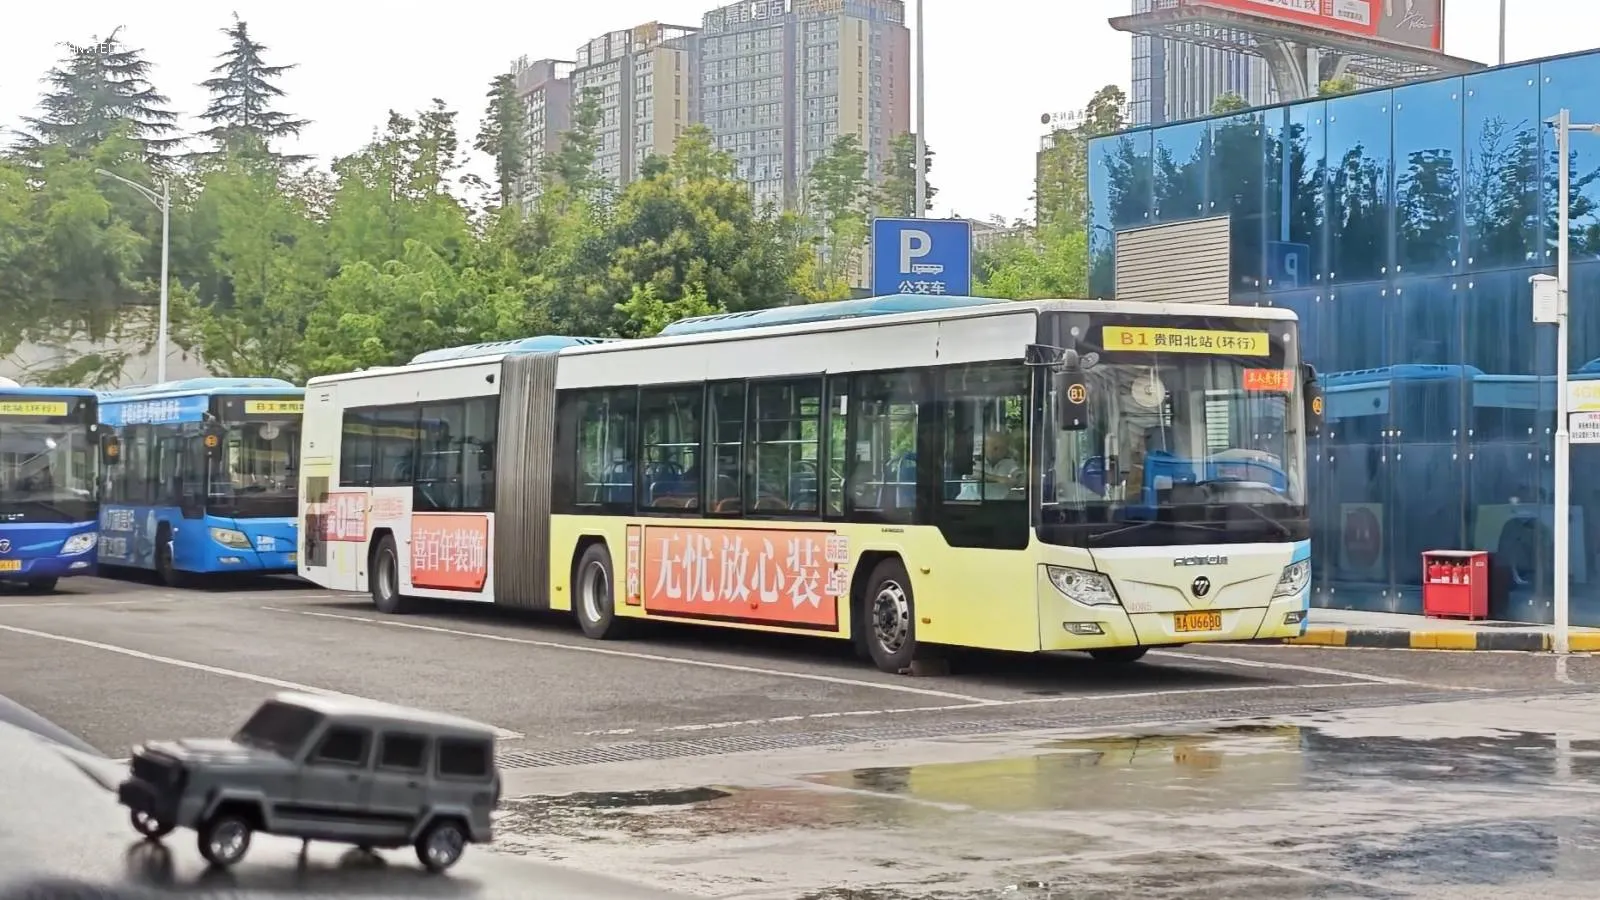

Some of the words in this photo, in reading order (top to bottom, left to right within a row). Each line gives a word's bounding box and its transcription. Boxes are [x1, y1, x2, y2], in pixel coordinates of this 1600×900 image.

[900, 229, 931, 273] P
[898, 280, 946, 294] 公交车
[1120, 332, 1148, 346] B1
[1154, 333, 1256, 350] 贵阳北站(环行)
[1071, 388, 1083, 401] B1
[413, 527, 484, 574] 喜百年装饰
[651, 532, 823, 610] 无忧放心装
